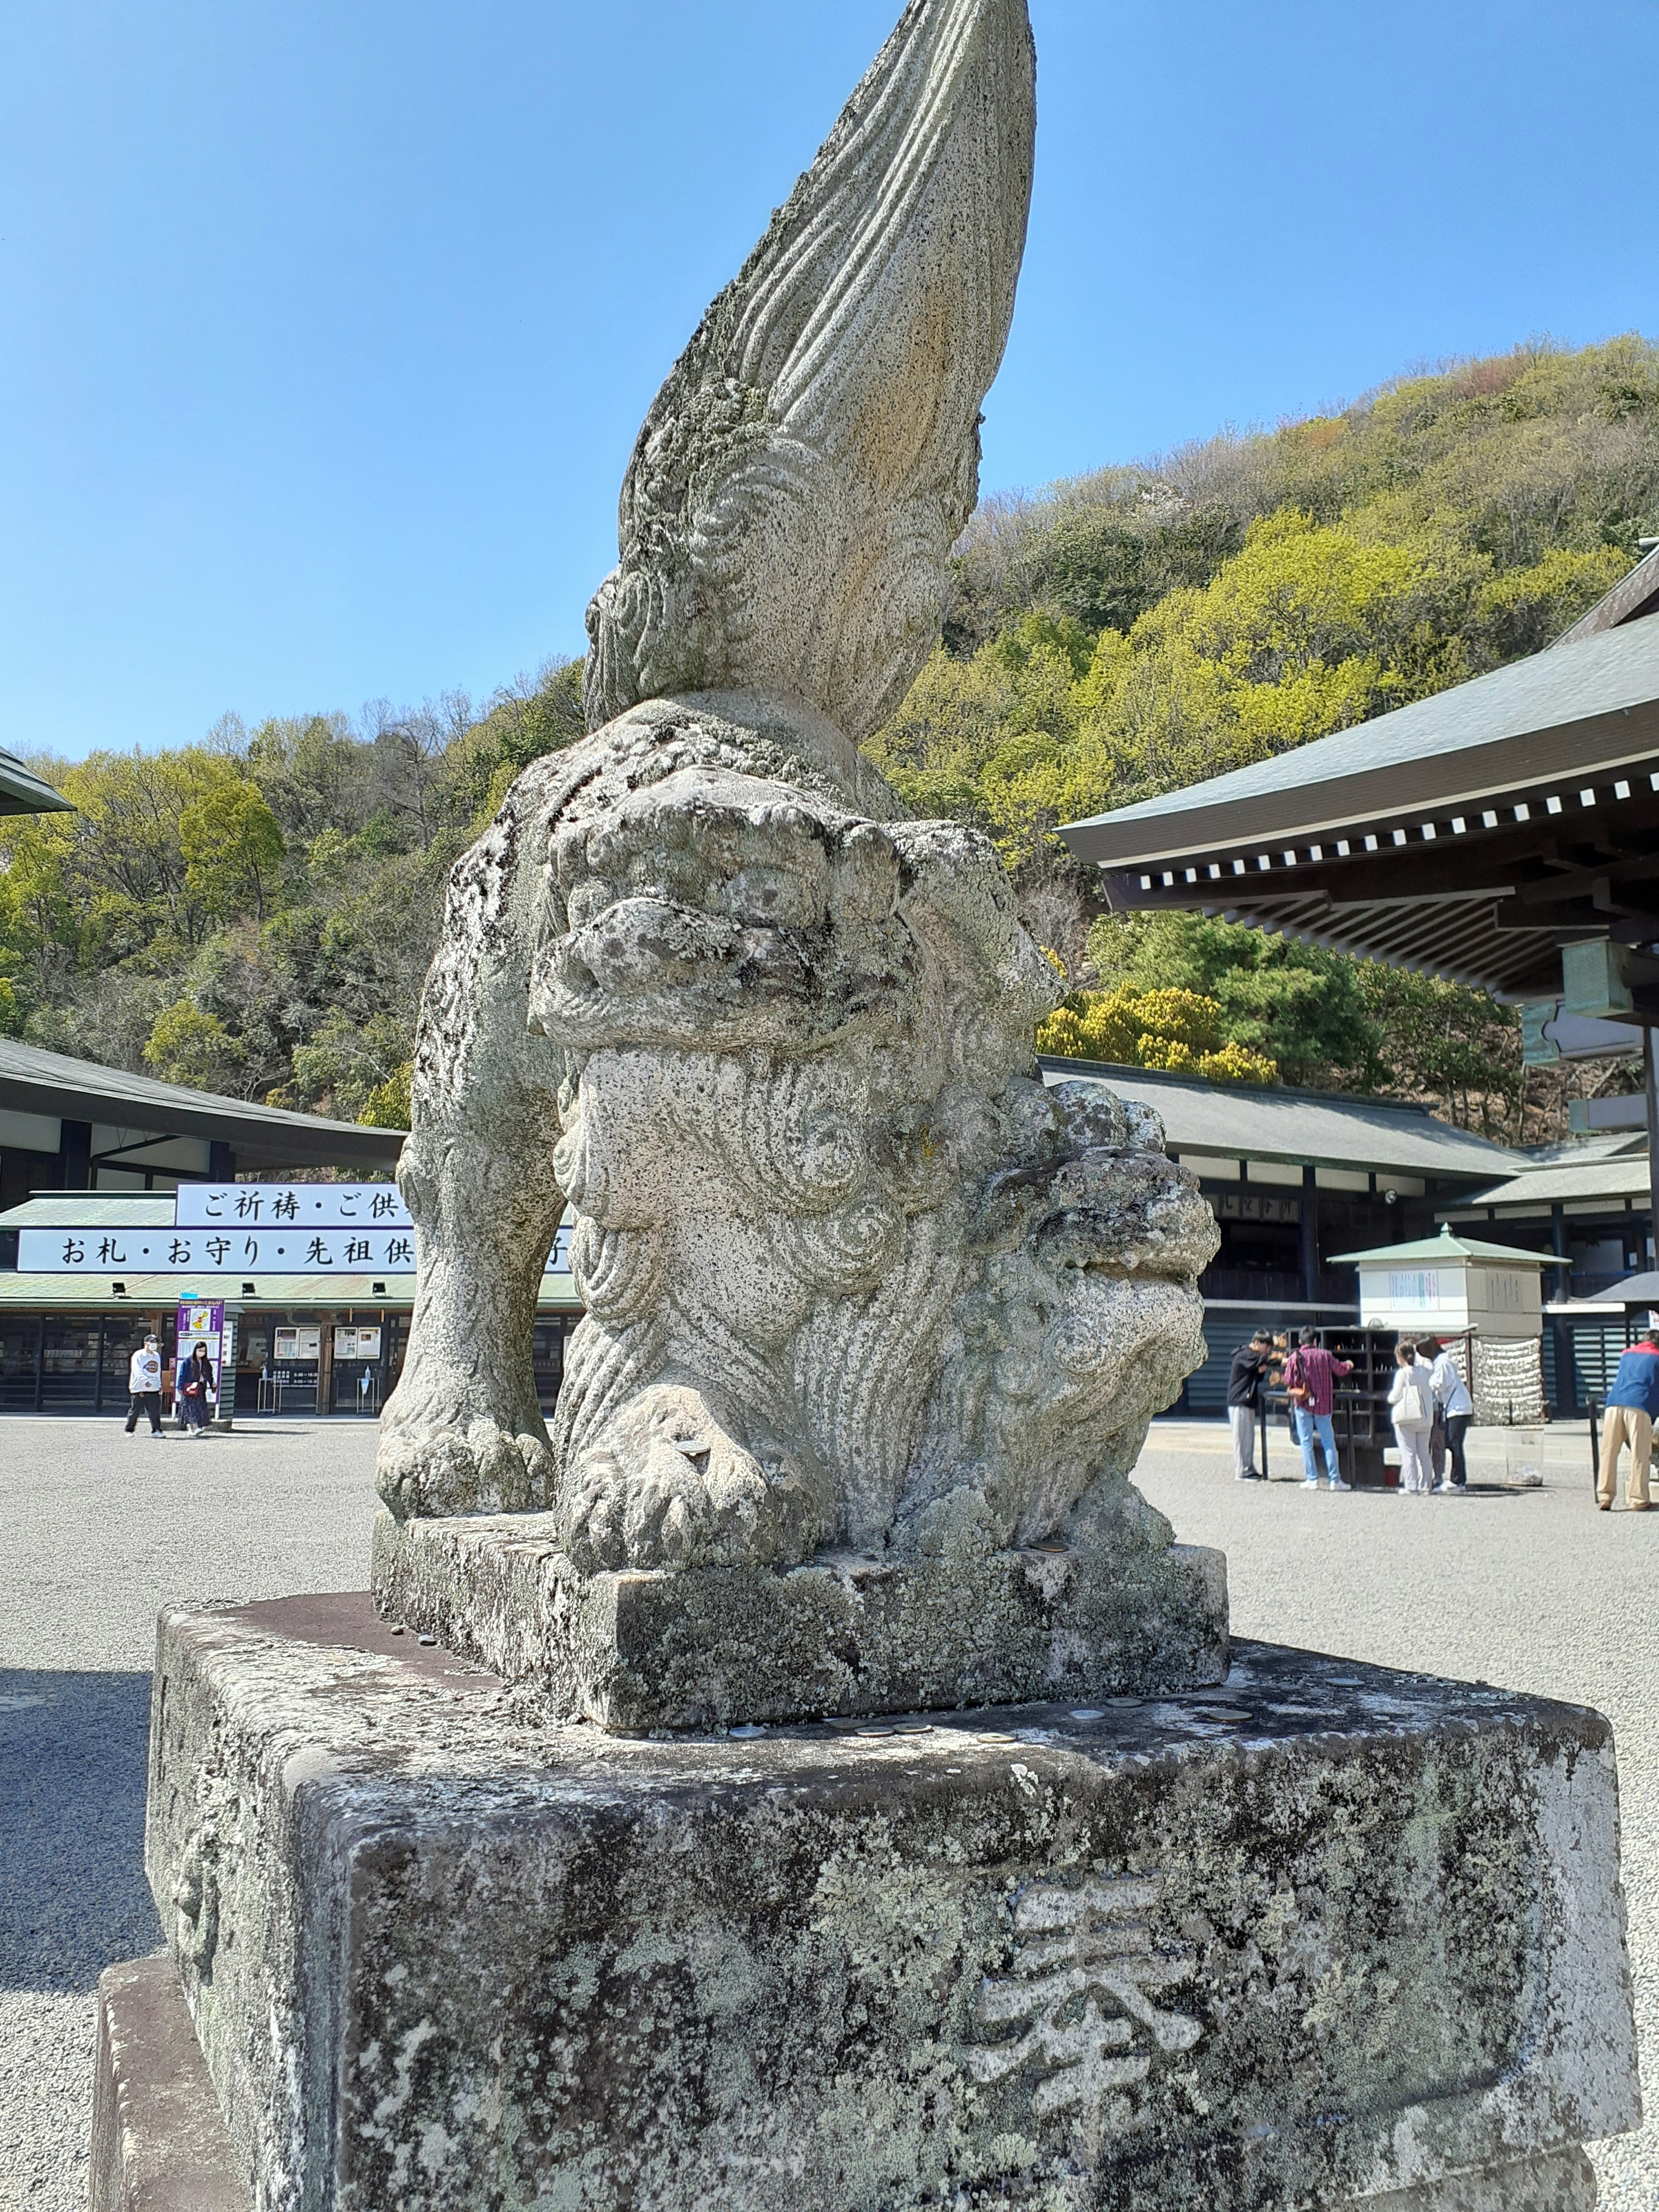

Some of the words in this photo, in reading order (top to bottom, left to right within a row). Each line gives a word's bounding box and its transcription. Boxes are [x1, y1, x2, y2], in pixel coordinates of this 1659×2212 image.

[206, 1190, 410, 1221] ご祈祷・ご供
[967, 1872, 1205, 2168] 奉
